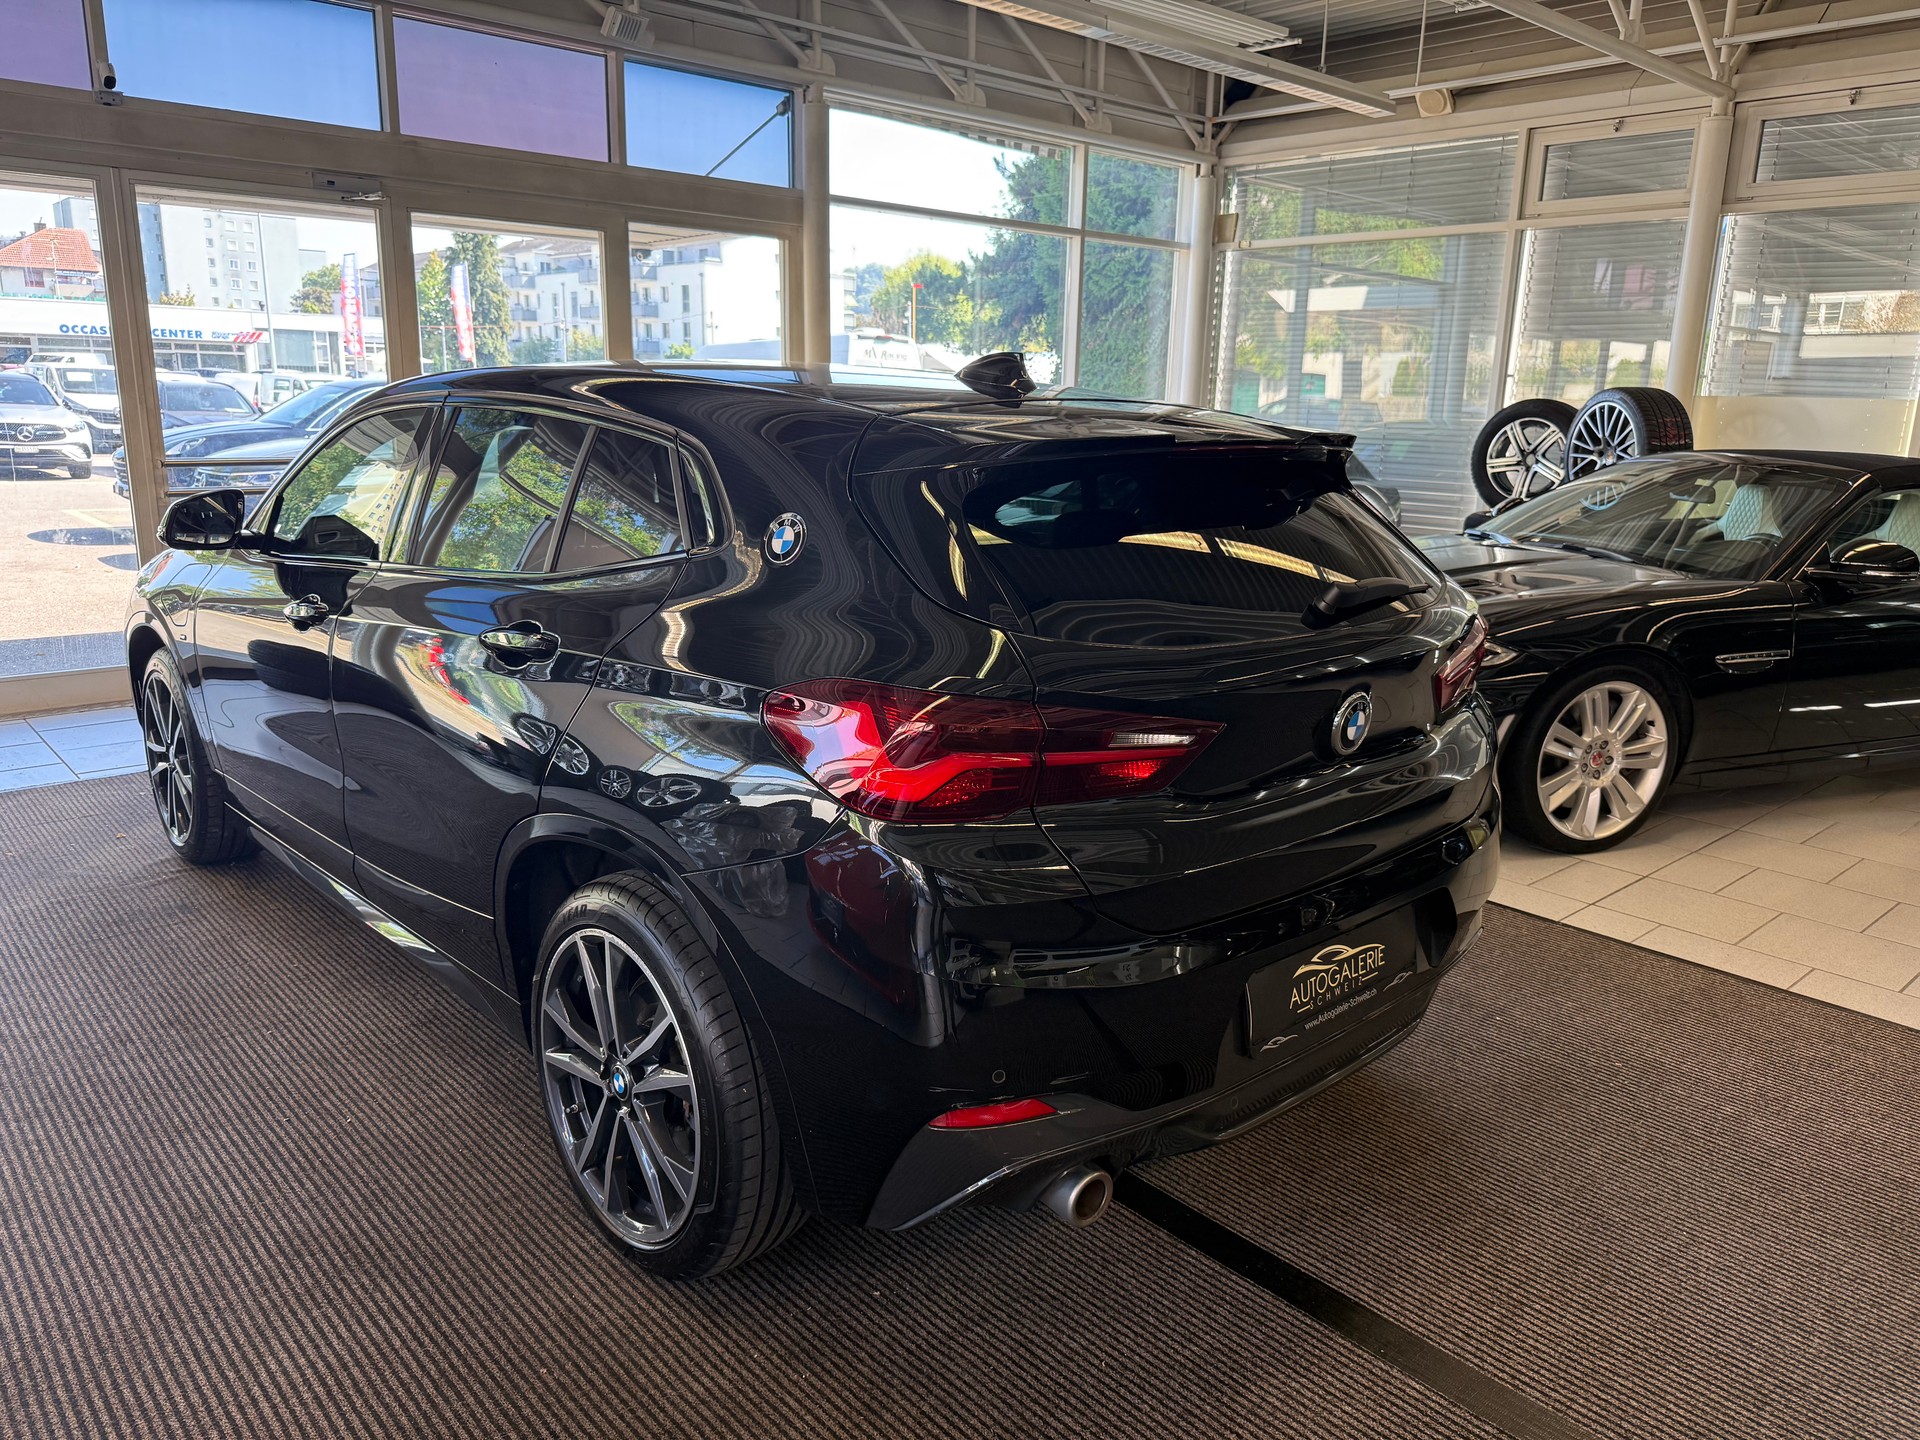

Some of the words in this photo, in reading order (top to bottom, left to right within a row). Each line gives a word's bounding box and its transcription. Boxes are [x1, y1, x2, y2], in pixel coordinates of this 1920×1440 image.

[59, 324, 108, 335] OCCAS
[152, 328, 203, 339] CENTER
[1289, 946, 1386, 1009] AUTOGALERIE
[1309, 976, 1363, 1010] SCHWEIZ
[1304, 988, 1377, 1030] www.Autogalerie-Schweiz.ch
